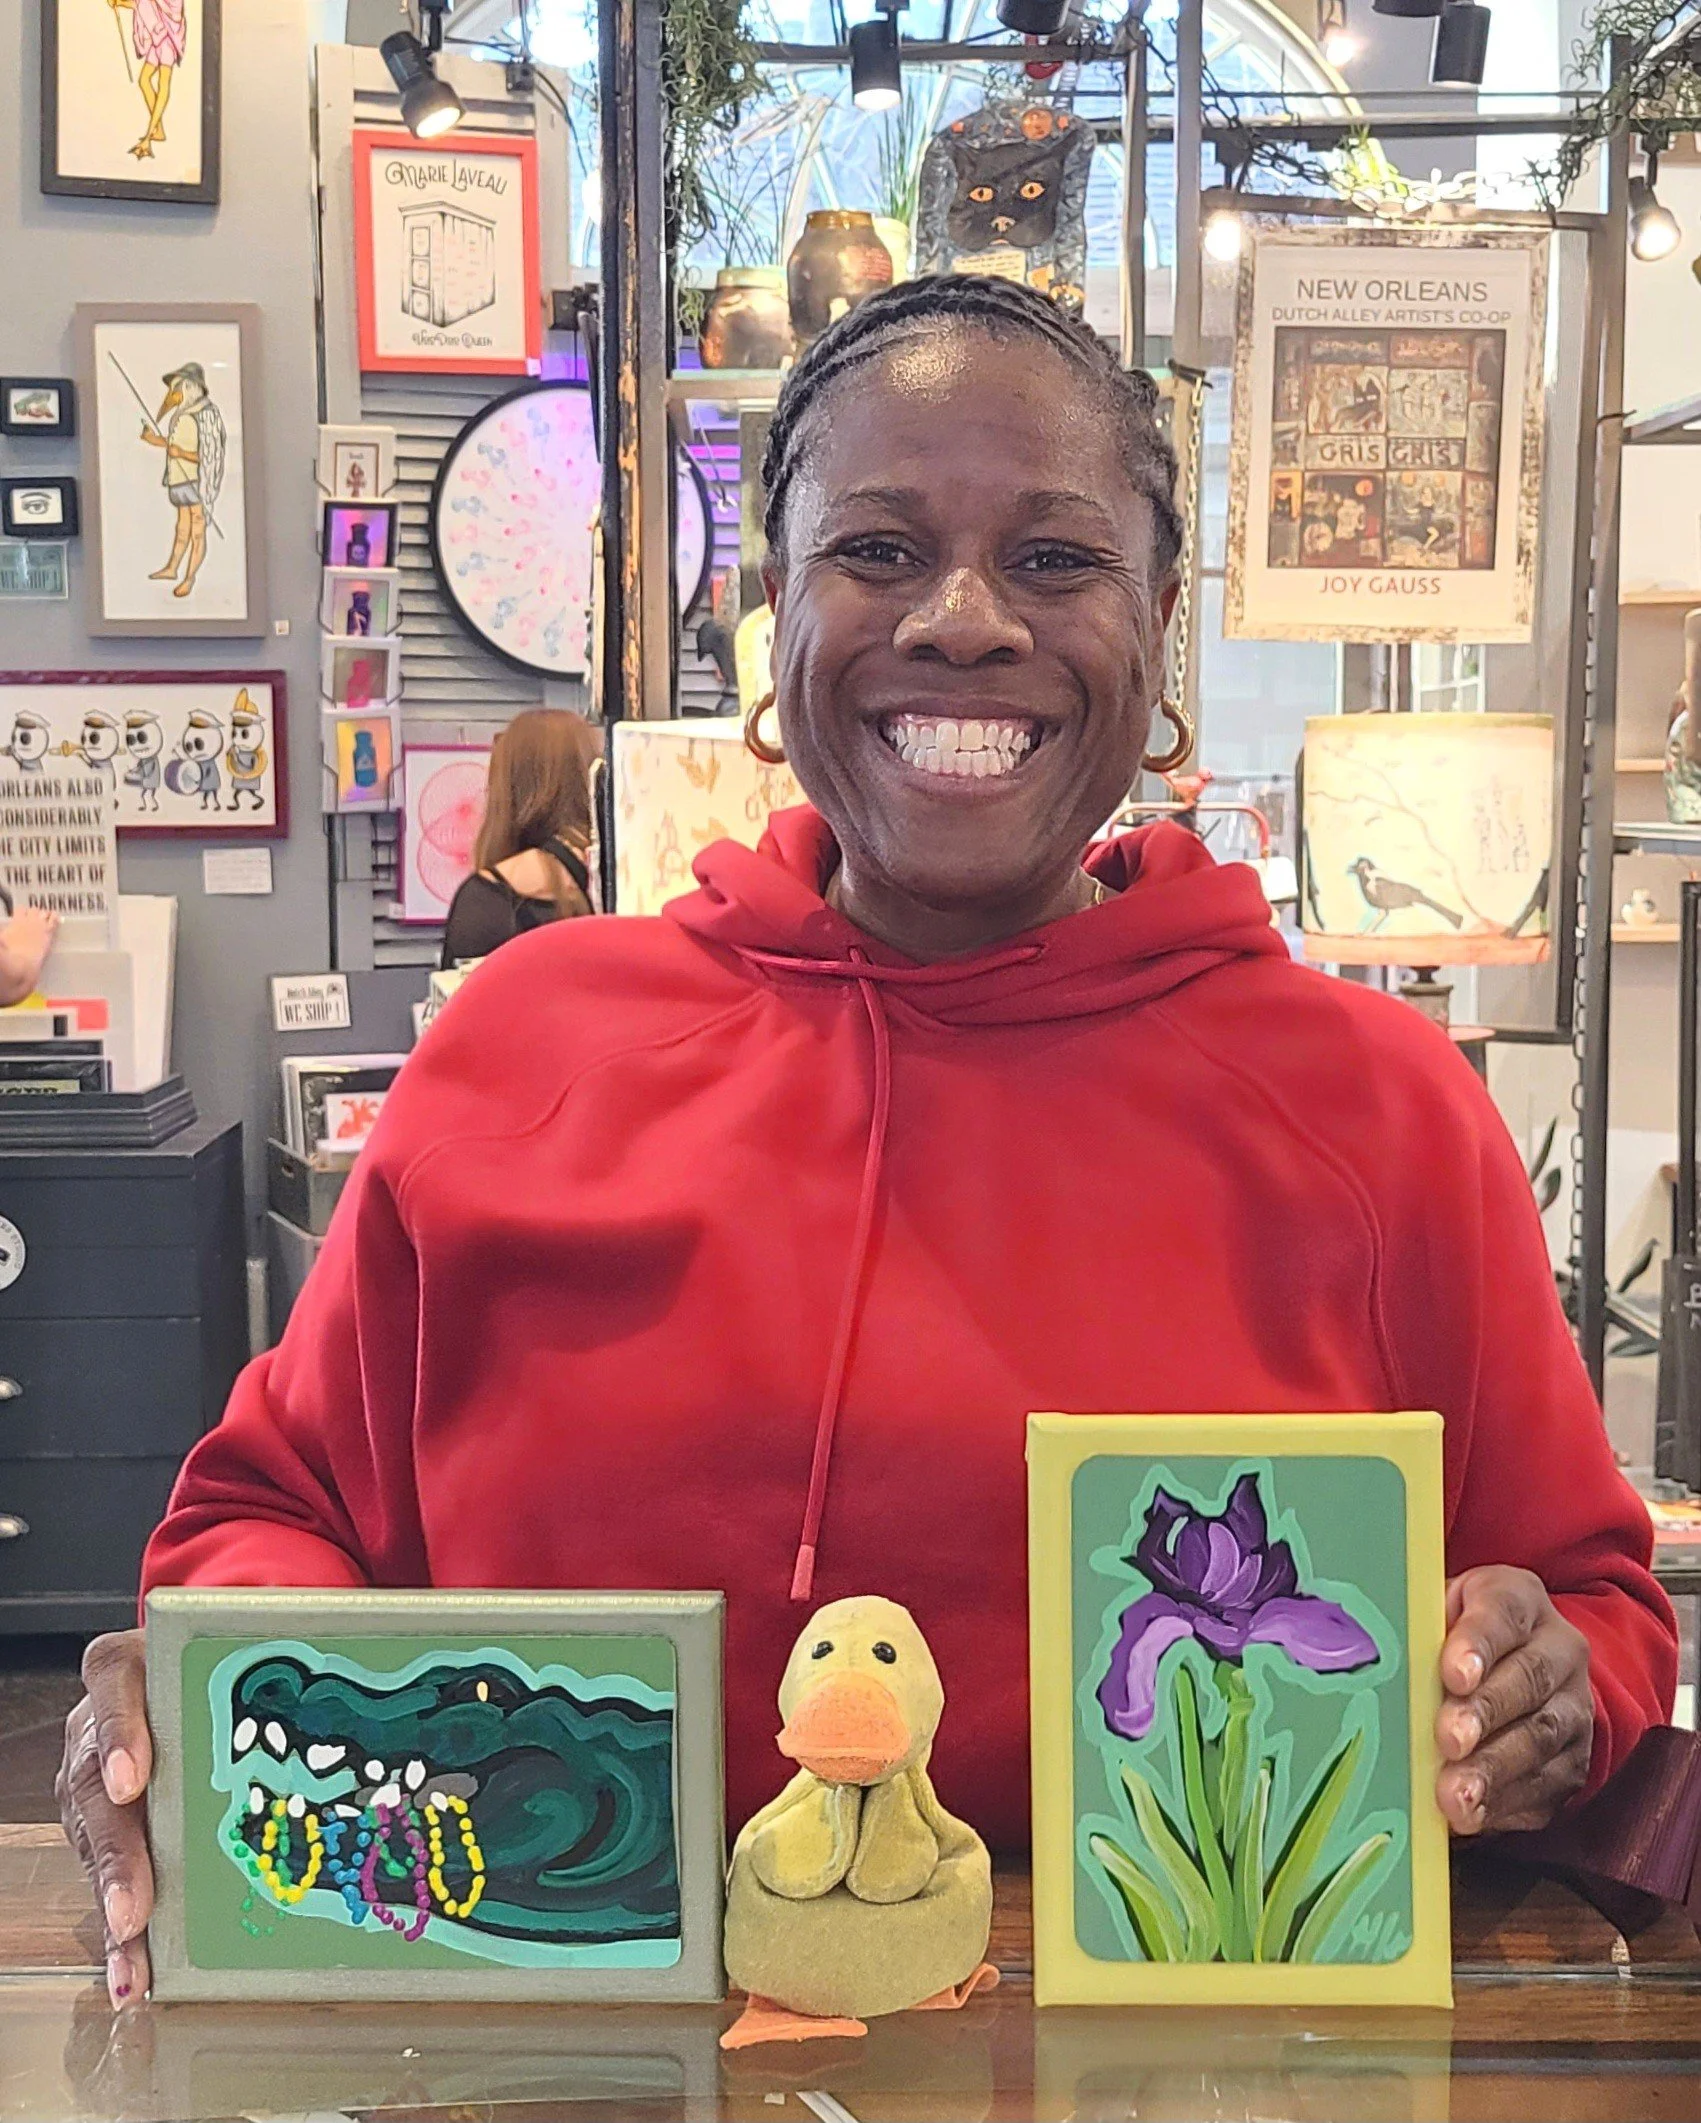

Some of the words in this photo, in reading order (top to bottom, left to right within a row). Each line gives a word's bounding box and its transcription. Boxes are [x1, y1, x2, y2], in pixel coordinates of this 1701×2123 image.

[385, 161, 448, 190] MARIE
[451, 158, 508, 195] LAVEAU
[1297, 279, 1357, 300] NEW
[1365, 280, 1489, 302] ORLEANS
[1272, 307, 1328, 321] DUTCH
[1331, 308, 1382, 322] ALLEY
[1458, 310, 1512, 324] CO-OP
[1319, 442, 1380, 463] GRIS
[1393, 442, 1450, 464] GRIS
[1319, 576, 1362, 594] JOY
[1368, 576, 1442, 595] GAUSS
[67, 778, 103, 797] ALSO
[19, 835, 52, 857] CITY
[56, 834, 106, 856] LIMITS
[5, 864, 32, 885] THE
[37, 864, 84, 884] HEART
[88, 863, 105, 884] OF
[284, 1003, 302, 1023] WE
